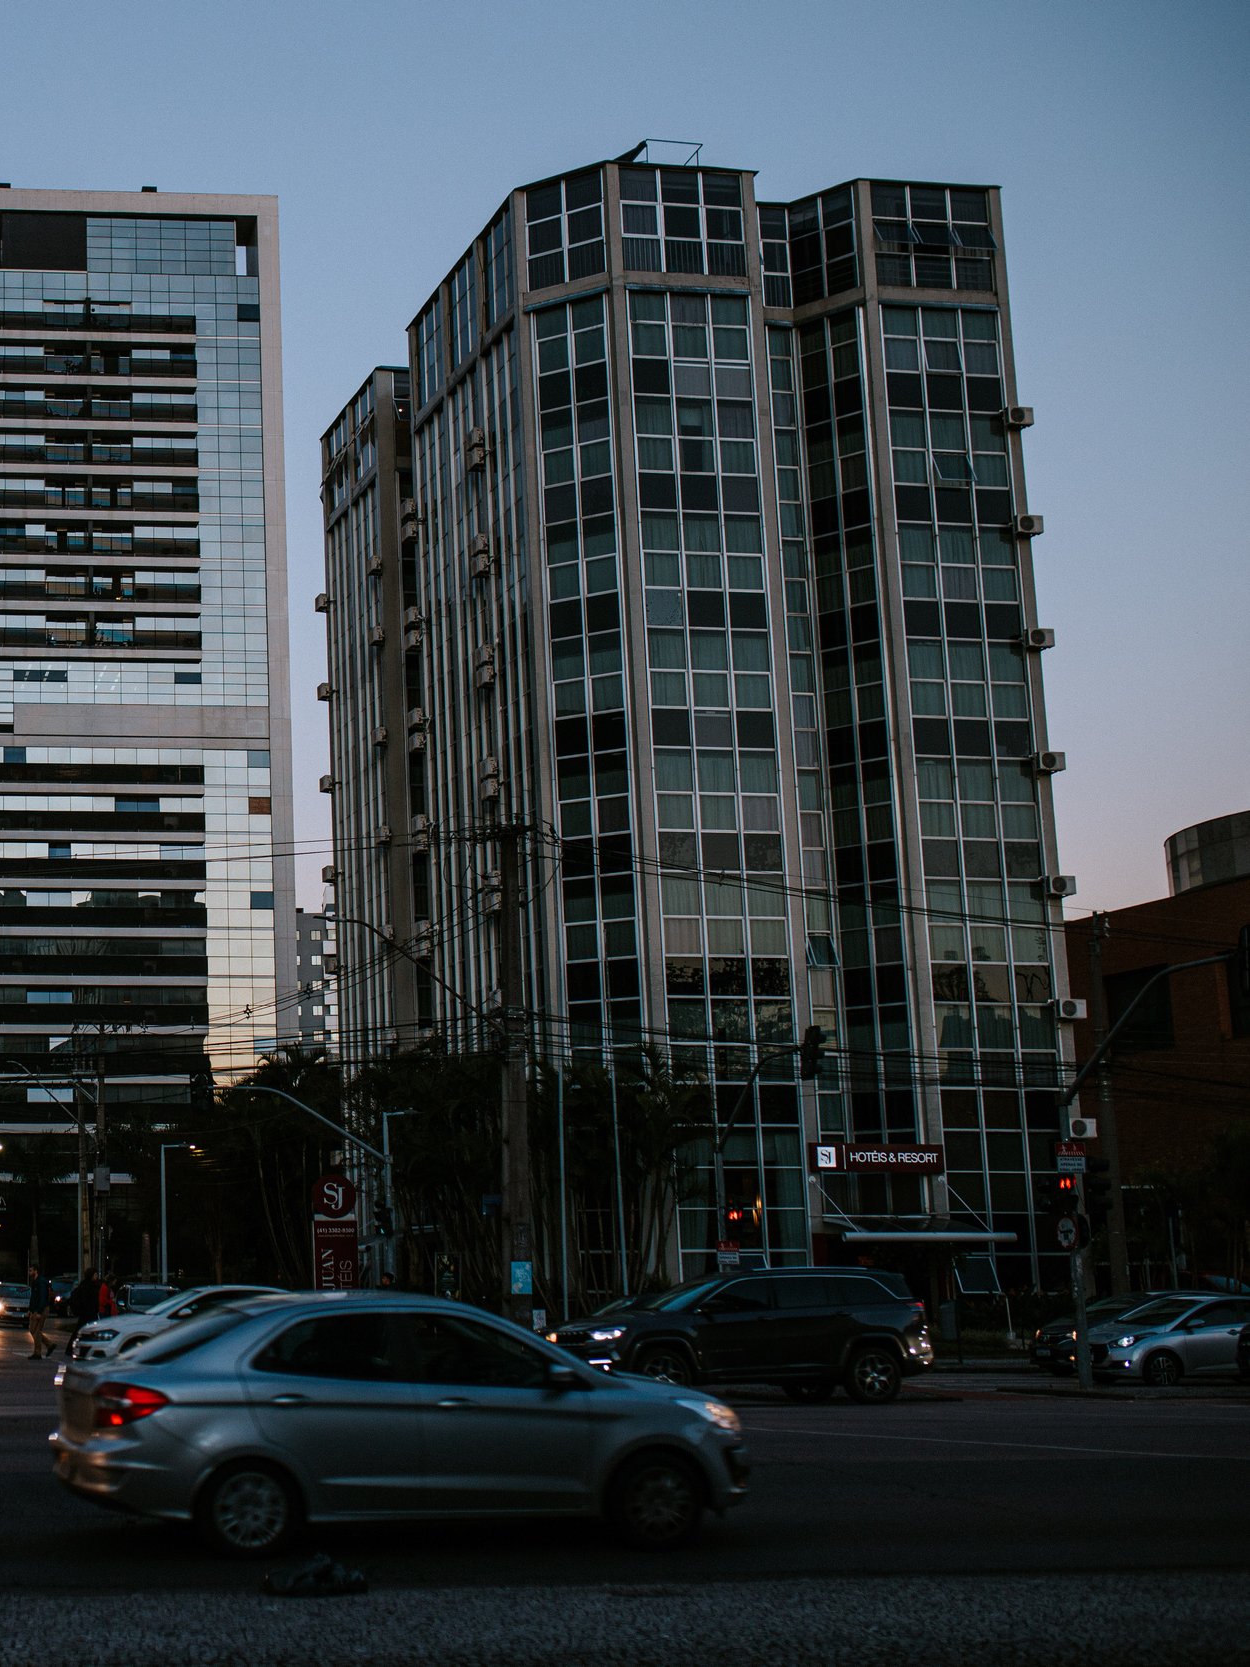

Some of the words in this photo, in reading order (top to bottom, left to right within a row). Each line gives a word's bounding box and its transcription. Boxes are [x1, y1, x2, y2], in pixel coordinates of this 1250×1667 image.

[850, 1150, 888, 1163] HOTÉIS
[888, 1153, 897, 1163] &
[897, 1153, 939, 1163] RESORT
[323, 1182, 346, 1211] SJ
[321, 1248, 336, 1290] JUAN
